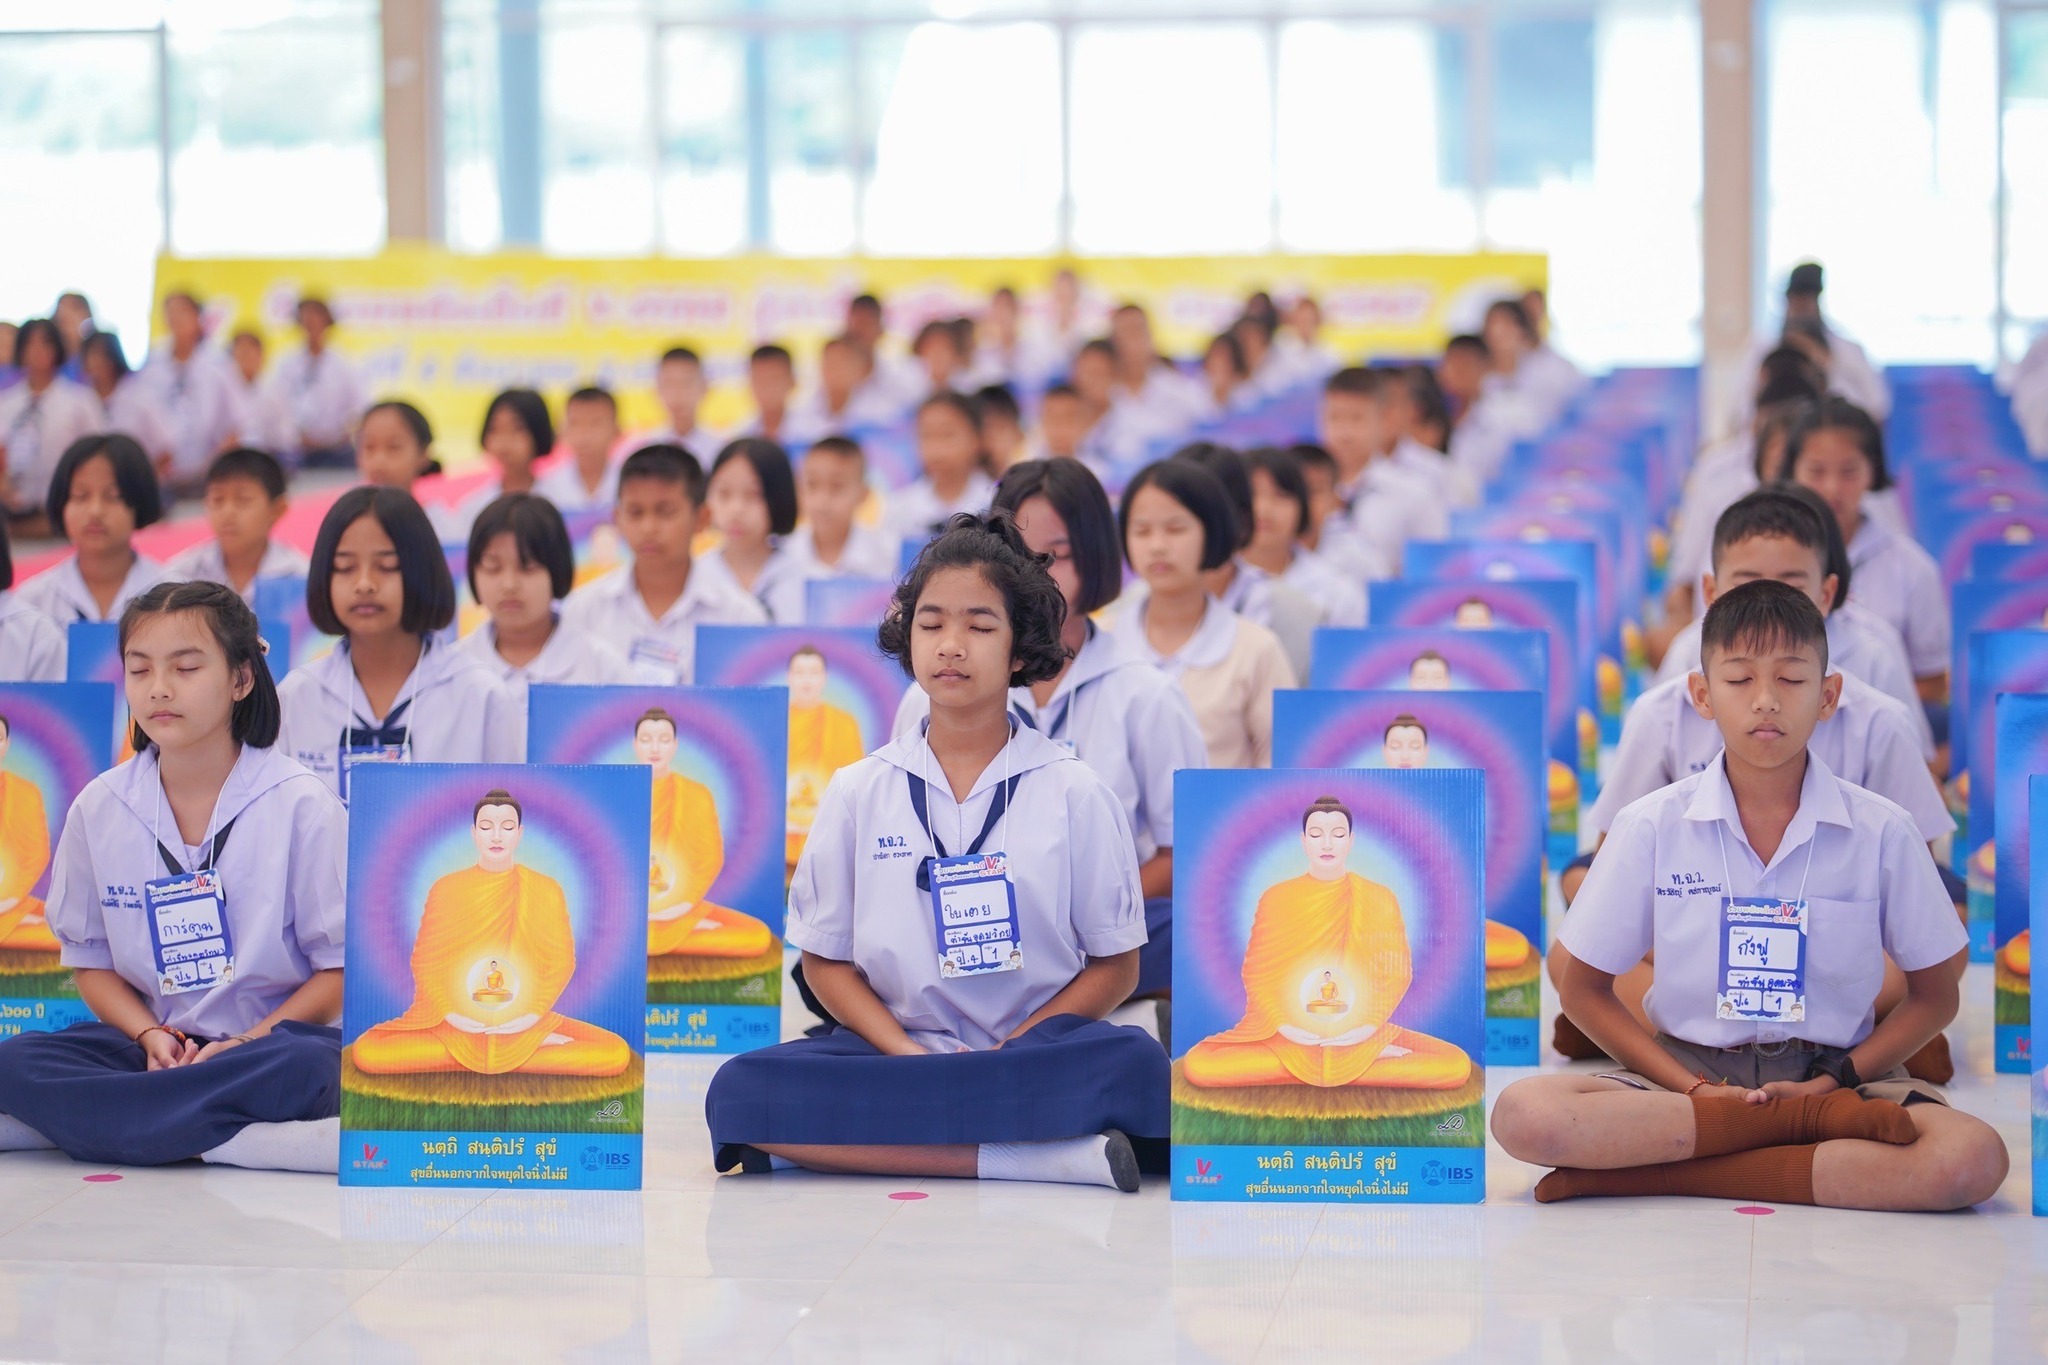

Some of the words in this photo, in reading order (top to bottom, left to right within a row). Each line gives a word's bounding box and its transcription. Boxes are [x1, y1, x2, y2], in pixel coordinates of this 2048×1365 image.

[363, 1143, 379, 1160] V
[535, 1138, 557, 1162] สุขํ
[606, 1153, 631, 1165] IBS
[1196, 1158, 1212, 1175] V
[1374, 1151, 1397, 1176] สุขํ
[1447, 1167, 1474, 1179] IBS
